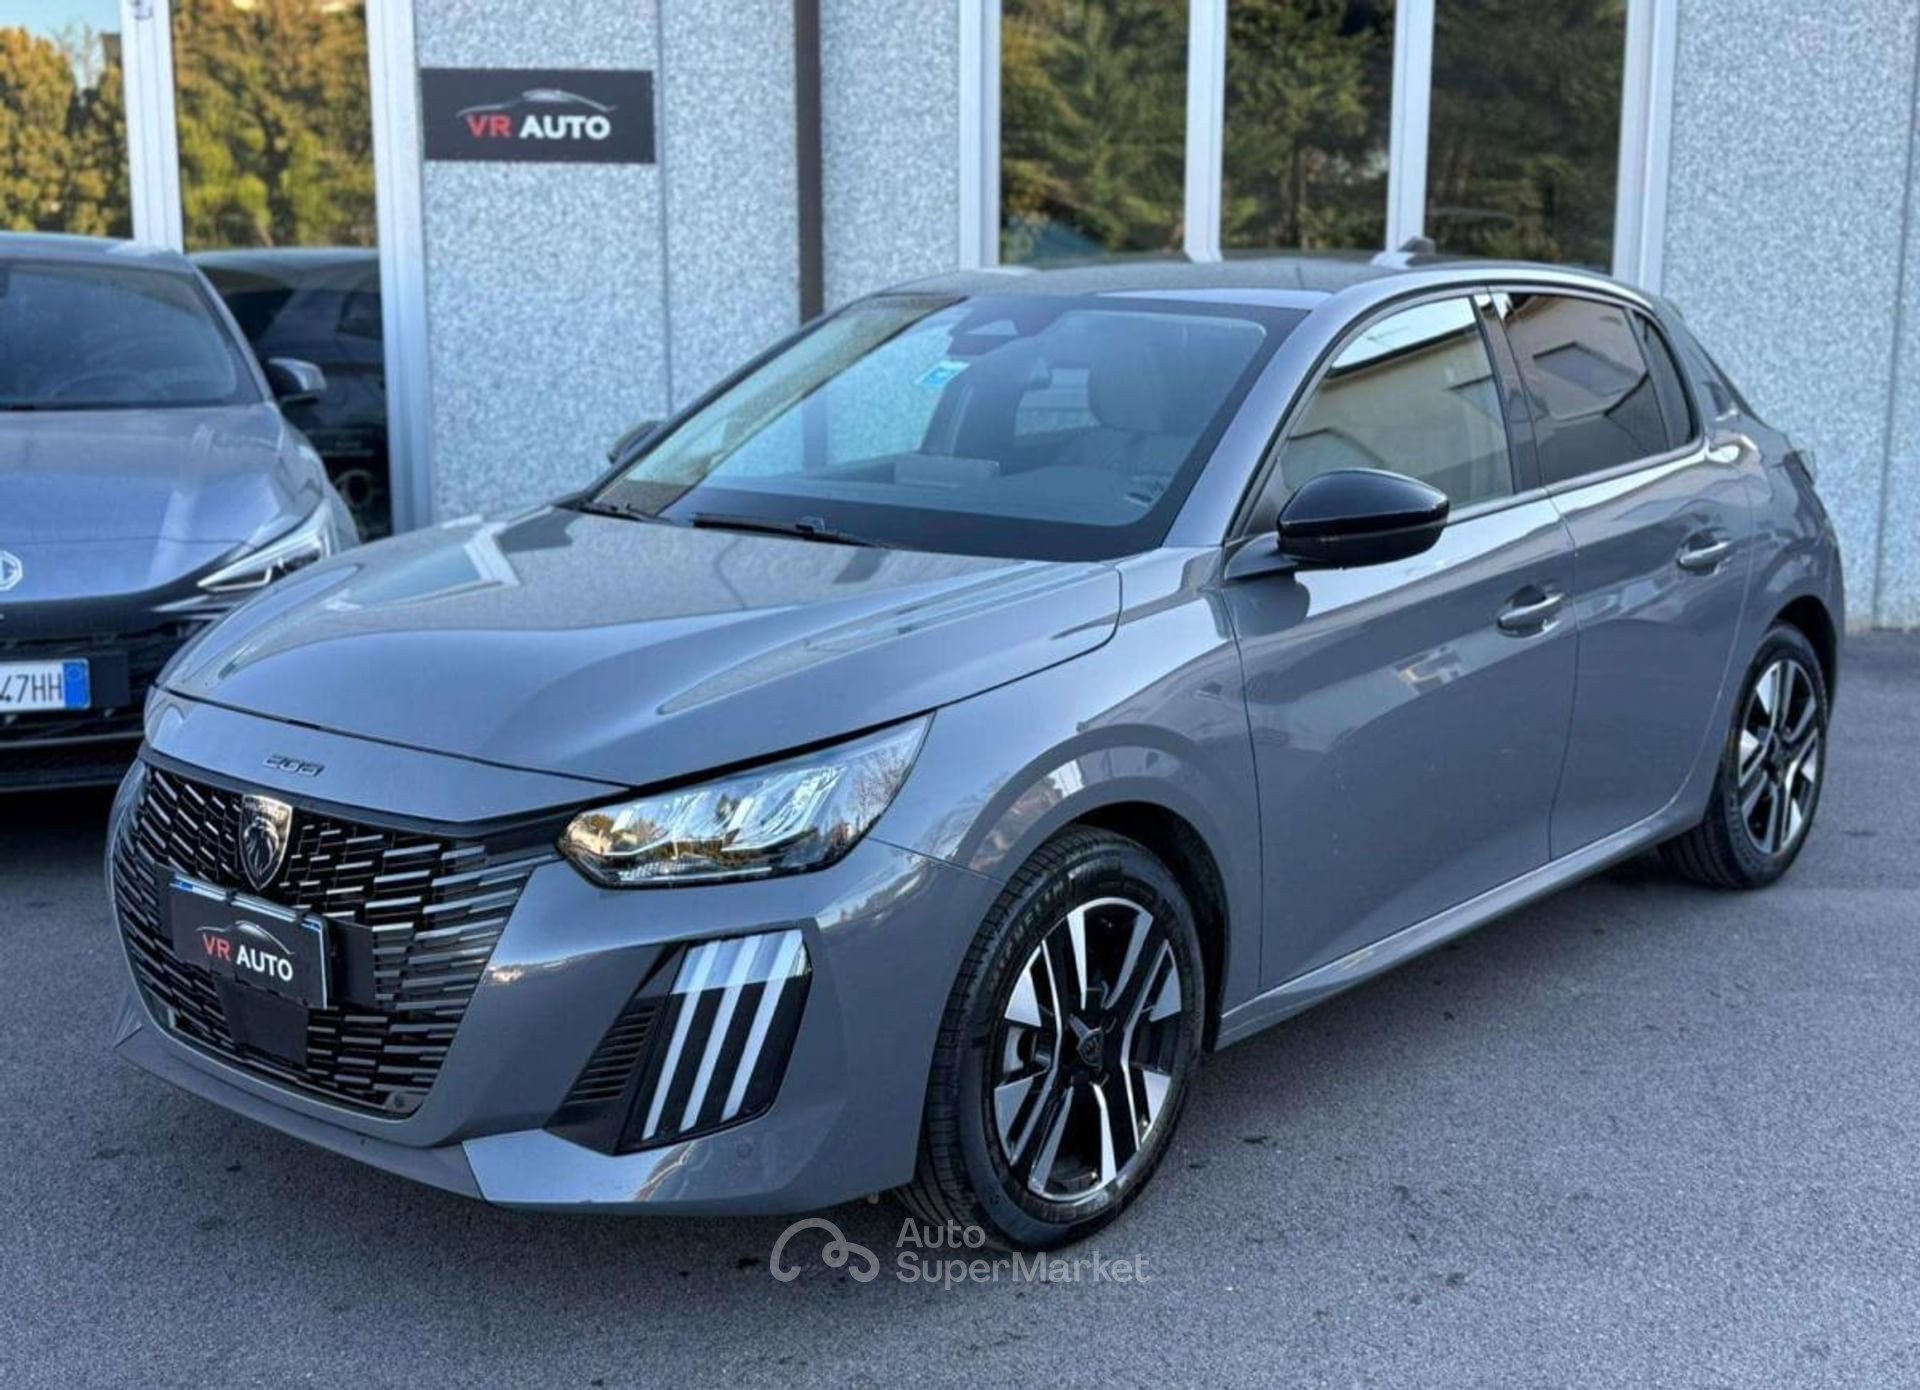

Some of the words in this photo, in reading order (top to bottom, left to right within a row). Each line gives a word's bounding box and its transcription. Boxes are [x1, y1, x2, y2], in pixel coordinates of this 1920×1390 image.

[466, 114, 512, 137] VR
[519, 114, 611, 139] AUTO
[203, 933, 231, 961] VR
[236, 944, 294, 982] AUTO
